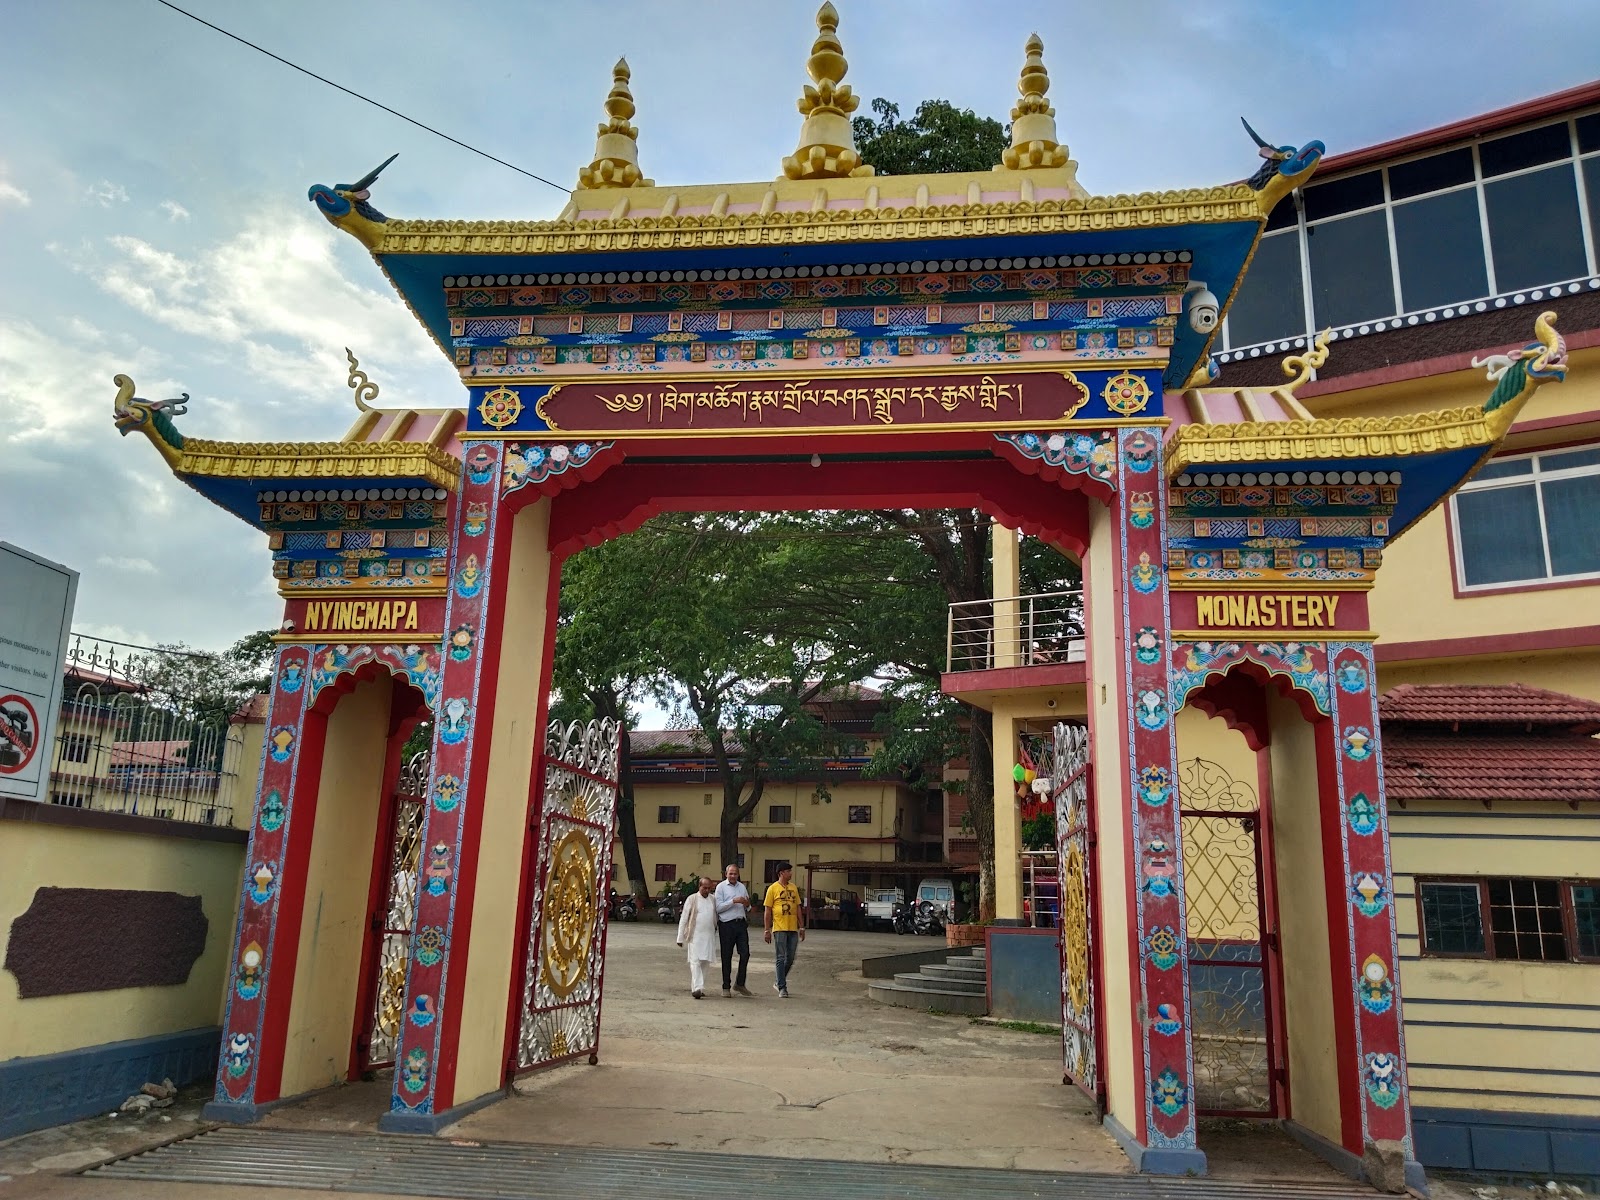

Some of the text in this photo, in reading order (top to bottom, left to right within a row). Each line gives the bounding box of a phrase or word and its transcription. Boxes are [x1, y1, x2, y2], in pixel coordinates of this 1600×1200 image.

[304, 601, 418, 630] NYINGMAPA
[1196, 595, 1339, 627] MONASTERY
[13, 641, 40, 655] monastery
[9, 731, 28, 756] CAMERA
